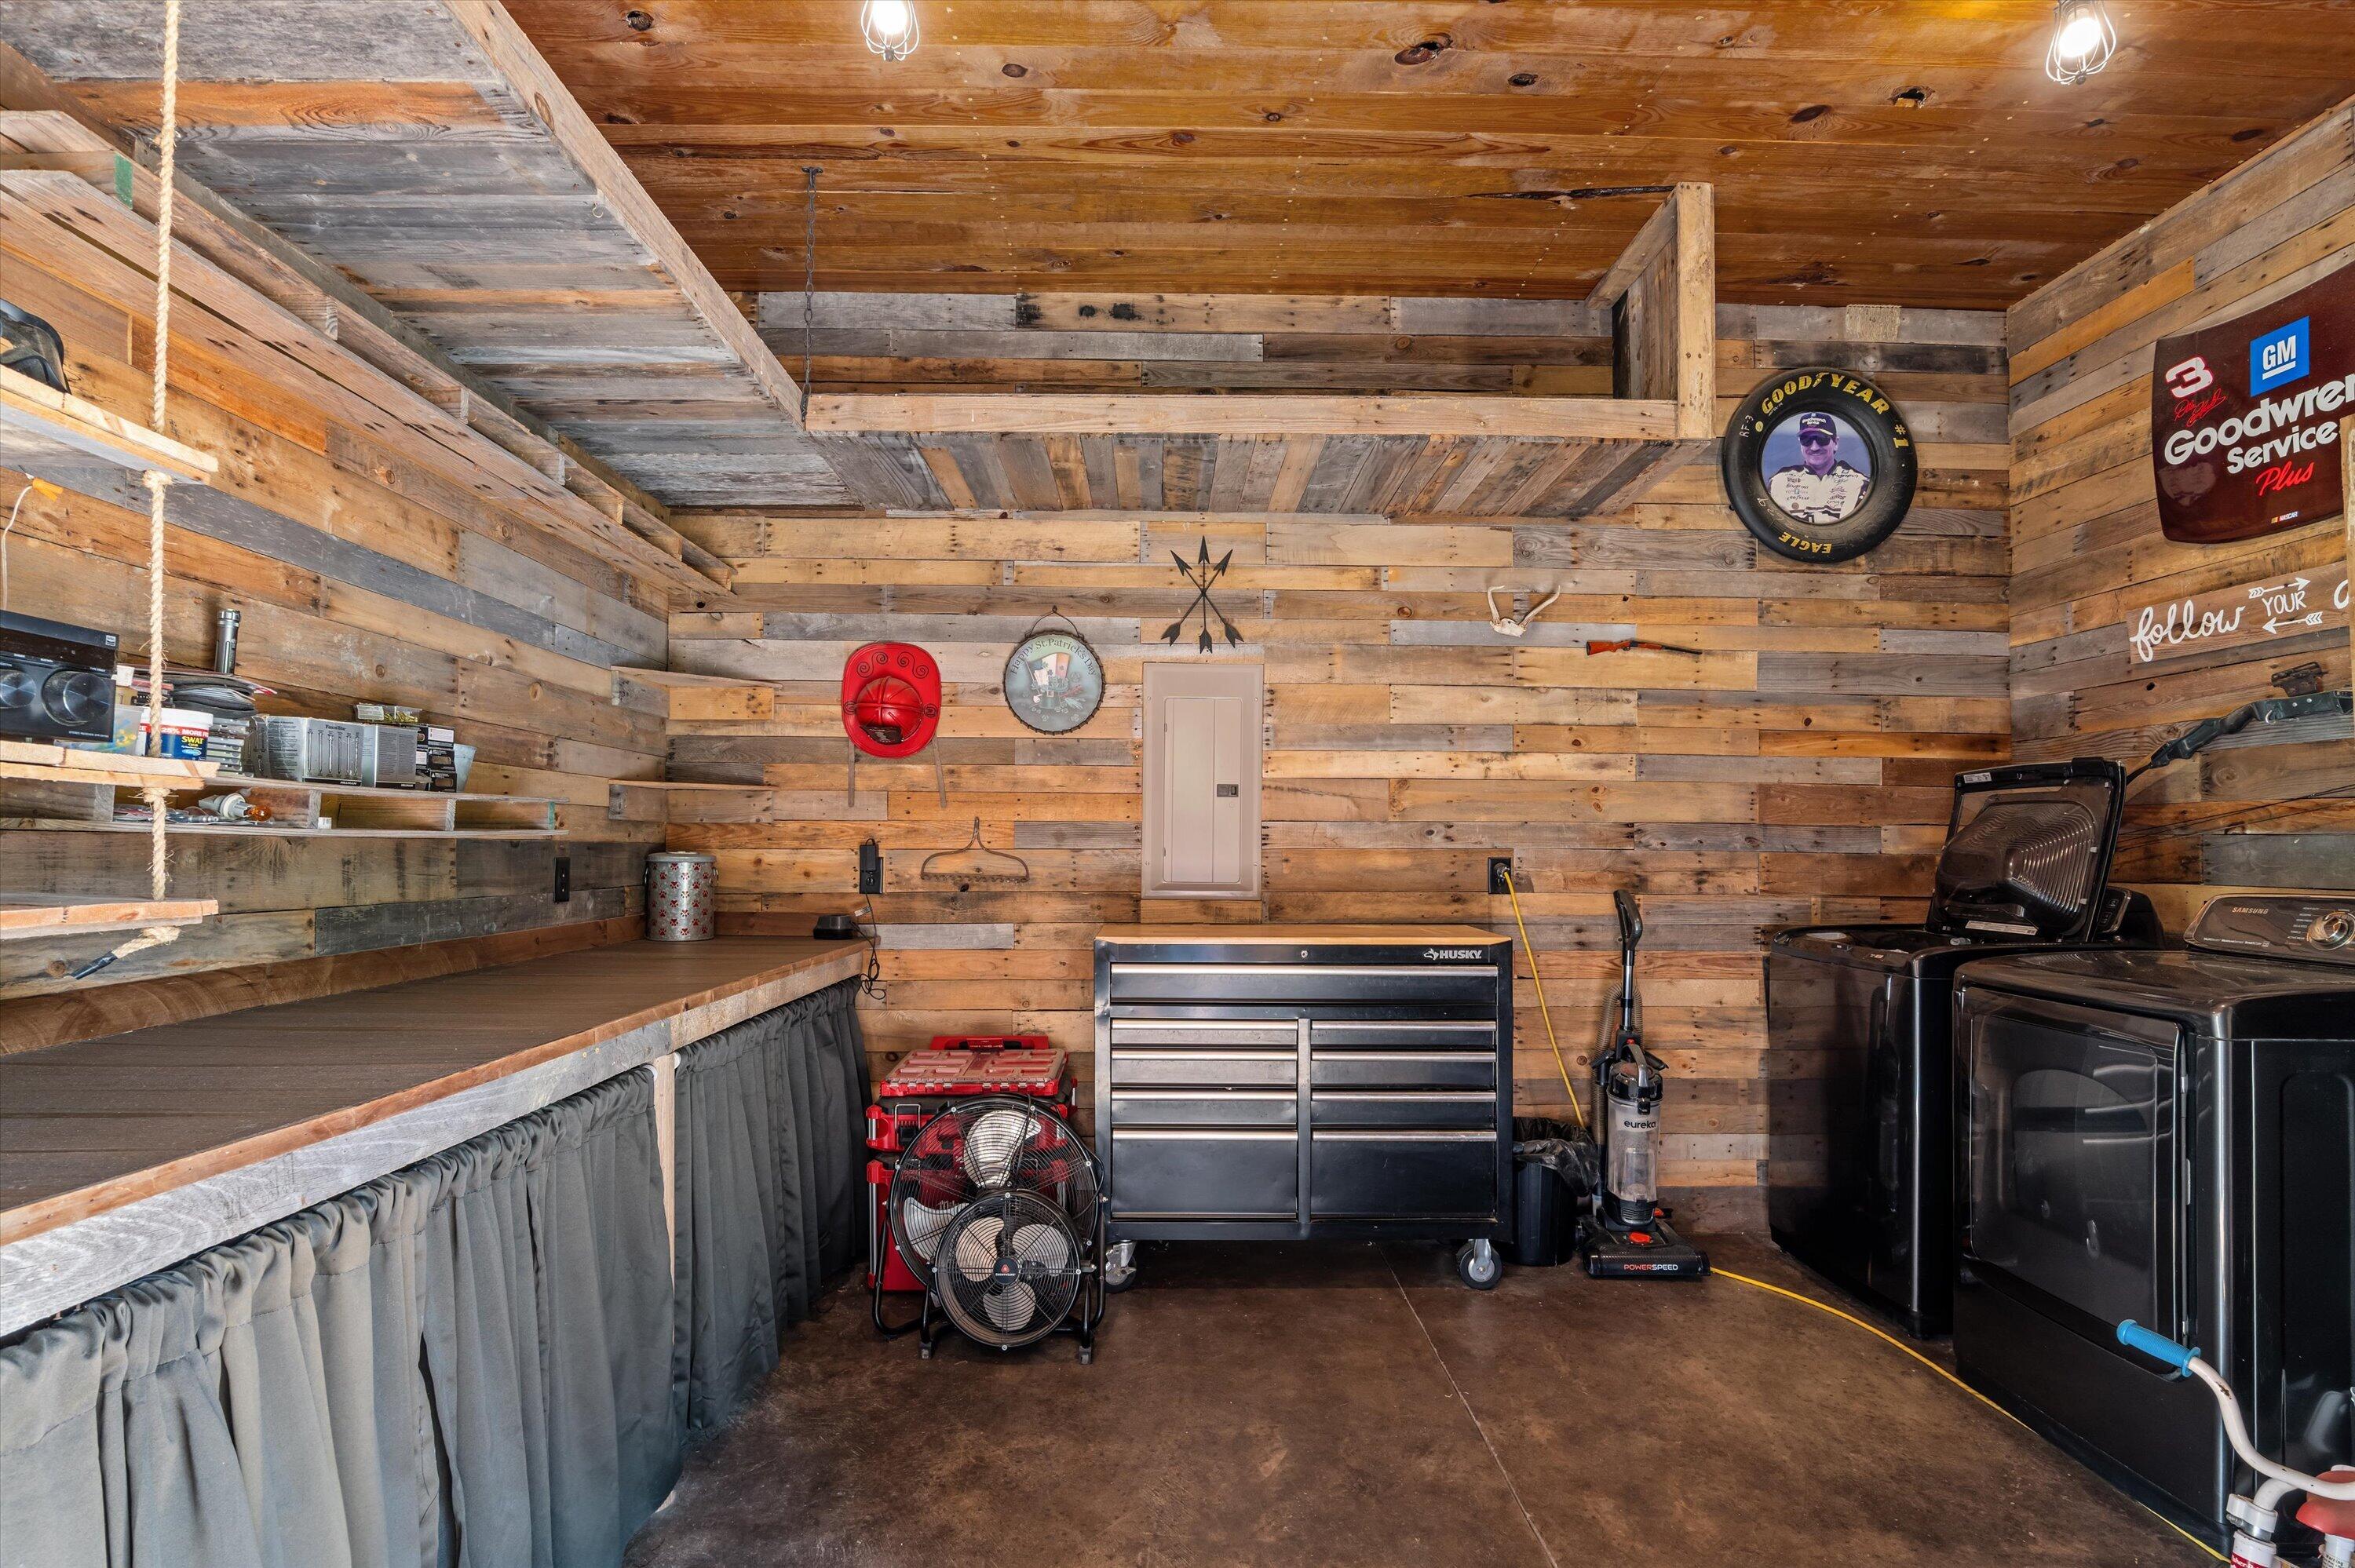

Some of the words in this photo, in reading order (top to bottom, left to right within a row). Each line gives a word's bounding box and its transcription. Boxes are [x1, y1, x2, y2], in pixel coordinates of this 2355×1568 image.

[2262, 335, 2296, 370] GM
[1762, 372, 1890, 415] GOODYEAR
[2165, 356, 2214, 398] 3
[2227, 421, 2338, 474] Service
[2255, 461, 2315, 496] Plus
[2279, 511, 2298, 521] NASCAR
[1778, 531, 1833, 554] EAGLE
[2130, 600, 2245, 662] follow
[2262, 590, 2306, 617] YOUR
[1010, 644, 1034, 675] Happy
[1048, 638, 1087, 660] Patrick's
[1084, 659, 1097, 676] Day
[181, 736, 204, 745] SWAT
[1439, 950, 1483, 959] HUSKY
[1623, 1120, 1656, 1129] eureka
